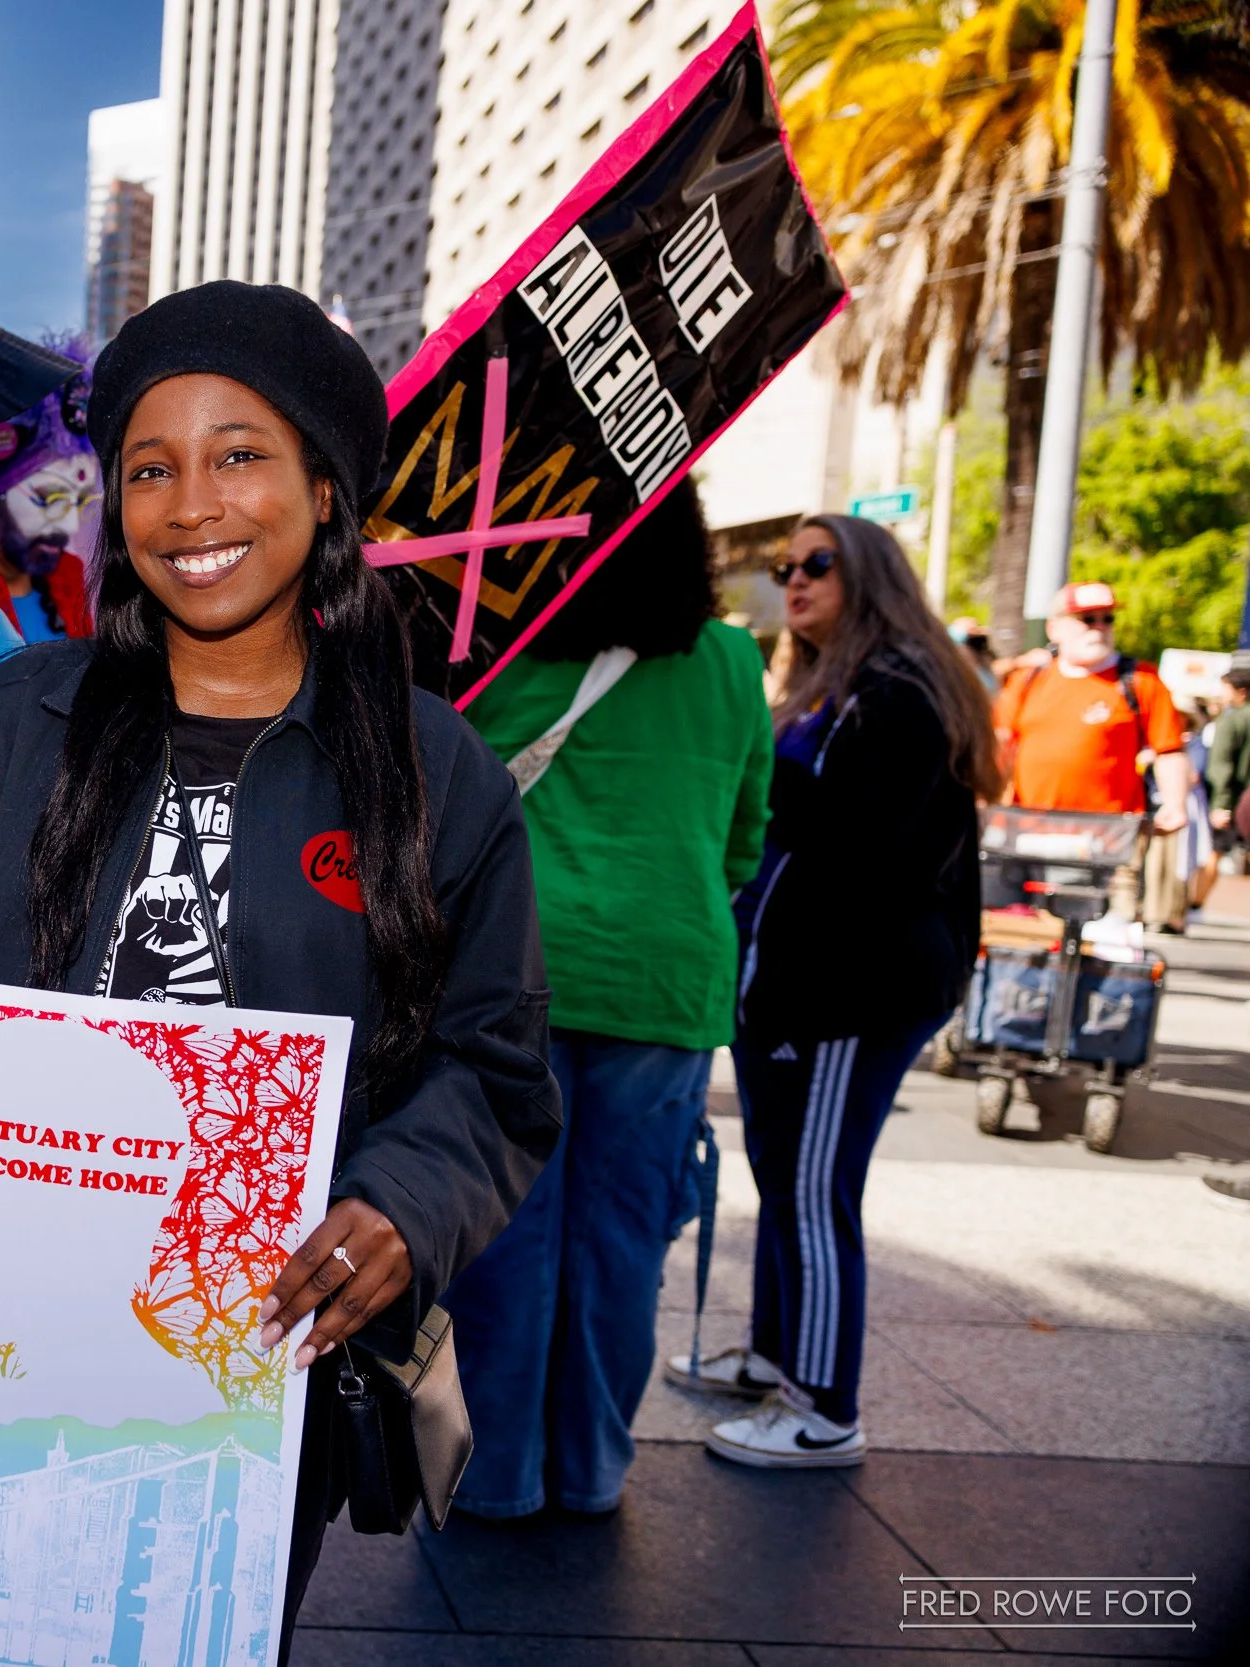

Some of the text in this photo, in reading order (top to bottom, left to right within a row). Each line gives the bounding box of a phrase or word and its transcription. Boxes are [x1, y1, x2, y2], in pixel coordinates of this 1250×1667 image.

[661, 208, 747, 345] DIE
[521, 238, 689, 495] ALREADY
[190, 795, 232, 836] Ma
[112, 1136, 186, 1161] CITY
[79, 1169, 169, 1196] HOME
